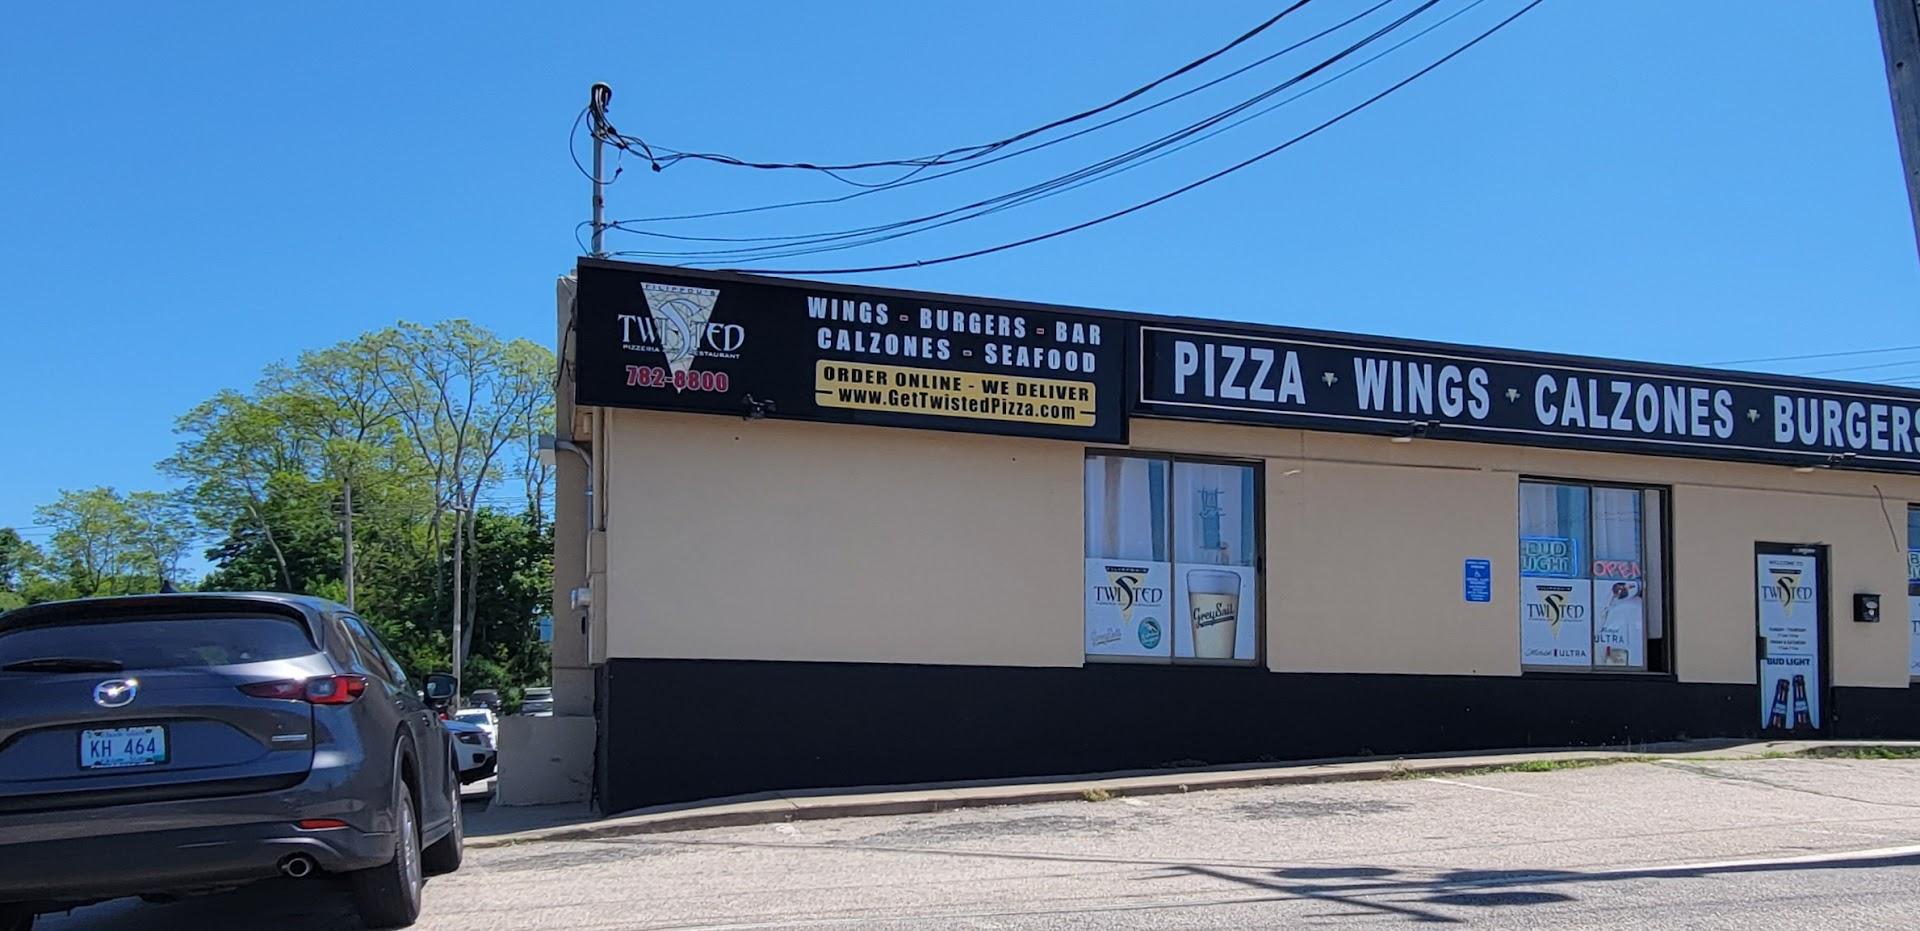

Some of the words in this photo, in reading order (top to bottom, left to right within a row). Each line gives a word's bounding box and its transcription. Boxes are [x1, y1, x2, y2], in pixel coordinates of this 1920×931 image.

[617, 298, 745, 363] TWISTED
[807, 296, 889, 325] WINGS
[919, 307, 1026, 338] BURGERS
[1055, 321, 1101, 345] BAR
[622, 344, 660, 353] PIZZERIA
[817, 327, 951, 360] CALZONES
[984, 343, 1096, 373] SEAFOOD
[625, 364, 729, 393] 782-8800
[823, 366, 888, 385] ORDER
[895, 372, 962, 391] ONLINE
[981, 379, 1009, 395] WE
[1016, 382, 1089, 401] DELIVER
[1174, 340, 1306, 405] PIZZA
[1353, 357, 1490, 420] WINGS
[1534, 373, 1734, 439] CALZONES
[838, 388, 1075, 420] www.GetTwistedPizza.com
[1093, 576, 1163, 611] TWISTED
[1761, 576, 1812, 607] TWISTED
[1526, 593, 1584, 626] TWISTED
[1559, 649, 1587, 657] ULTRA
[1594, 634, 1625, 643] ULTRA
[1767, 657, 1784, 666] BUD
[1786, 658, 1810, 666] LIGHT
[90, 740, 111, 758] KH
[124, 737, 156, 755] 464
